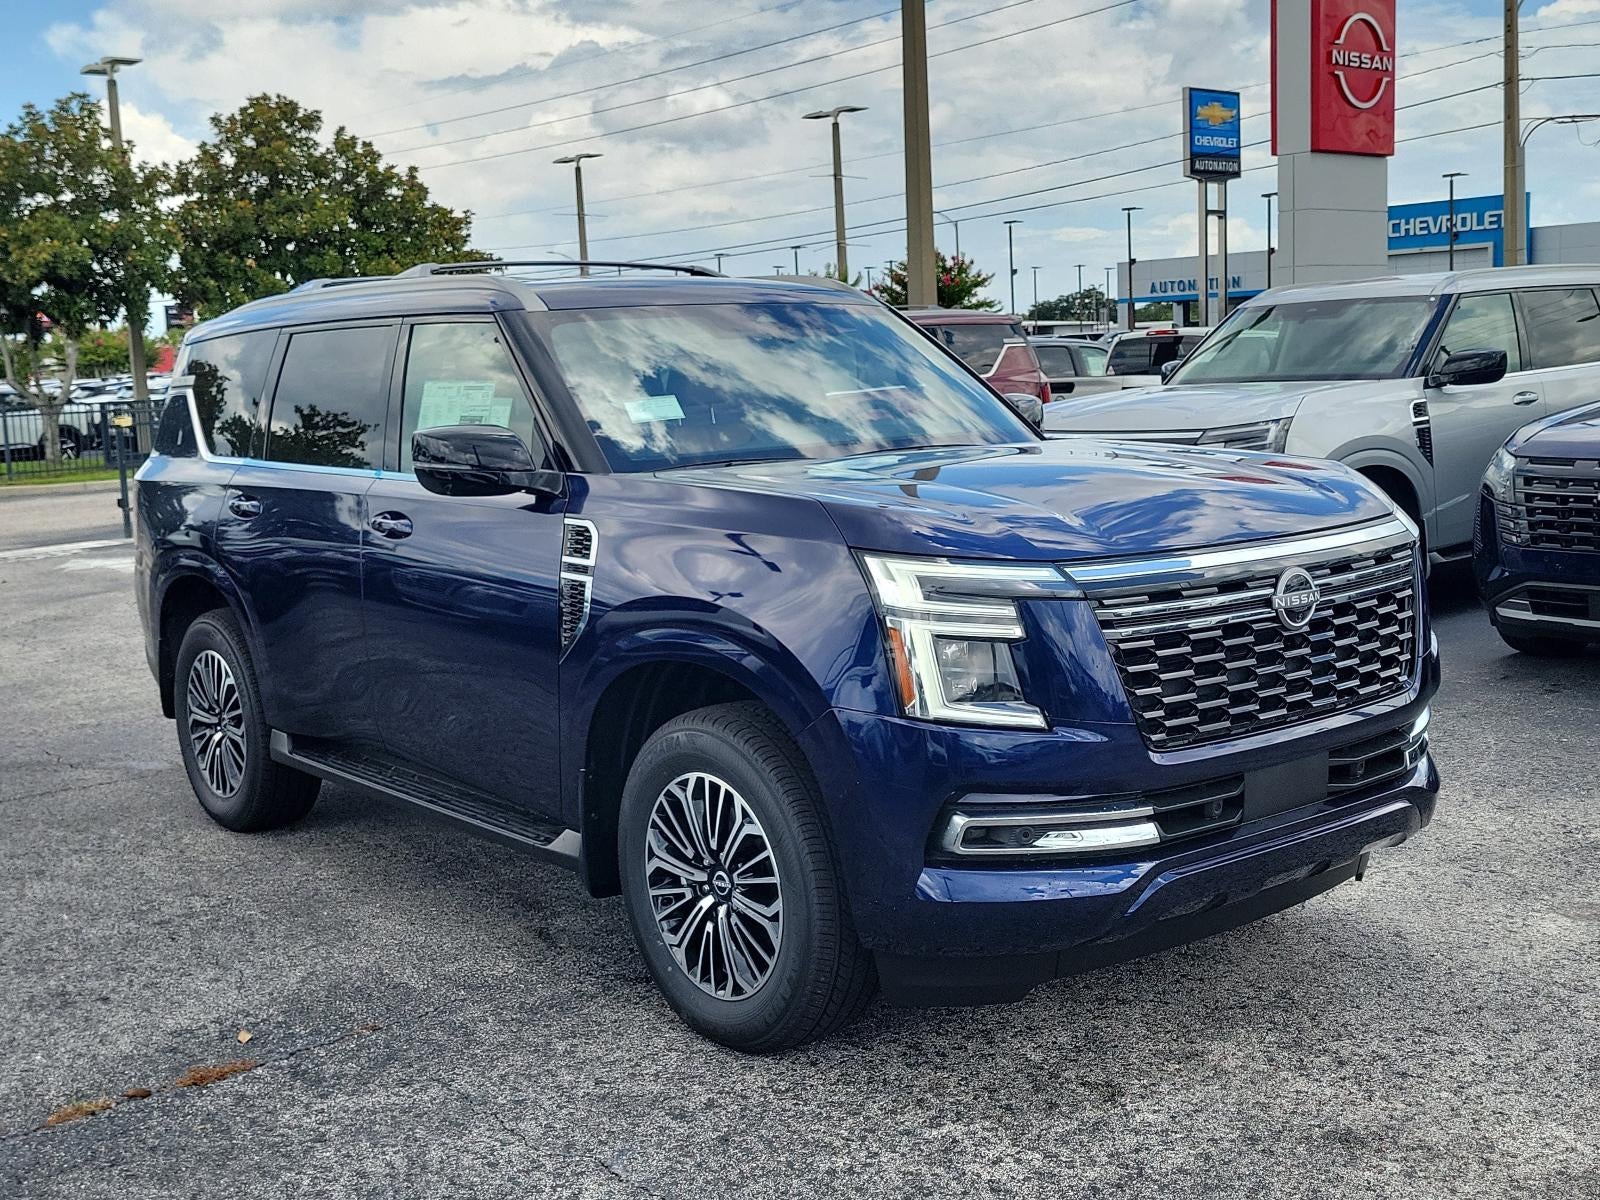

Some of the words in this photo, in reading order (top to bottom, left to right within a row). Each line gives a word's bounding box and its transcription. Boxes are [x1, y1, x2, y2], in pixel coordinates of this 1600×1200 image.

[1332, 49, 1392, 71] NISSAN
[1194, 135, 1237, 148] CHEVROLET
[1194, 160, 1239, 172] AUTONATION
[1150, 275, 1240, 294] AUTONTIN
[1275, 591, 1320, 607] NISSAN
